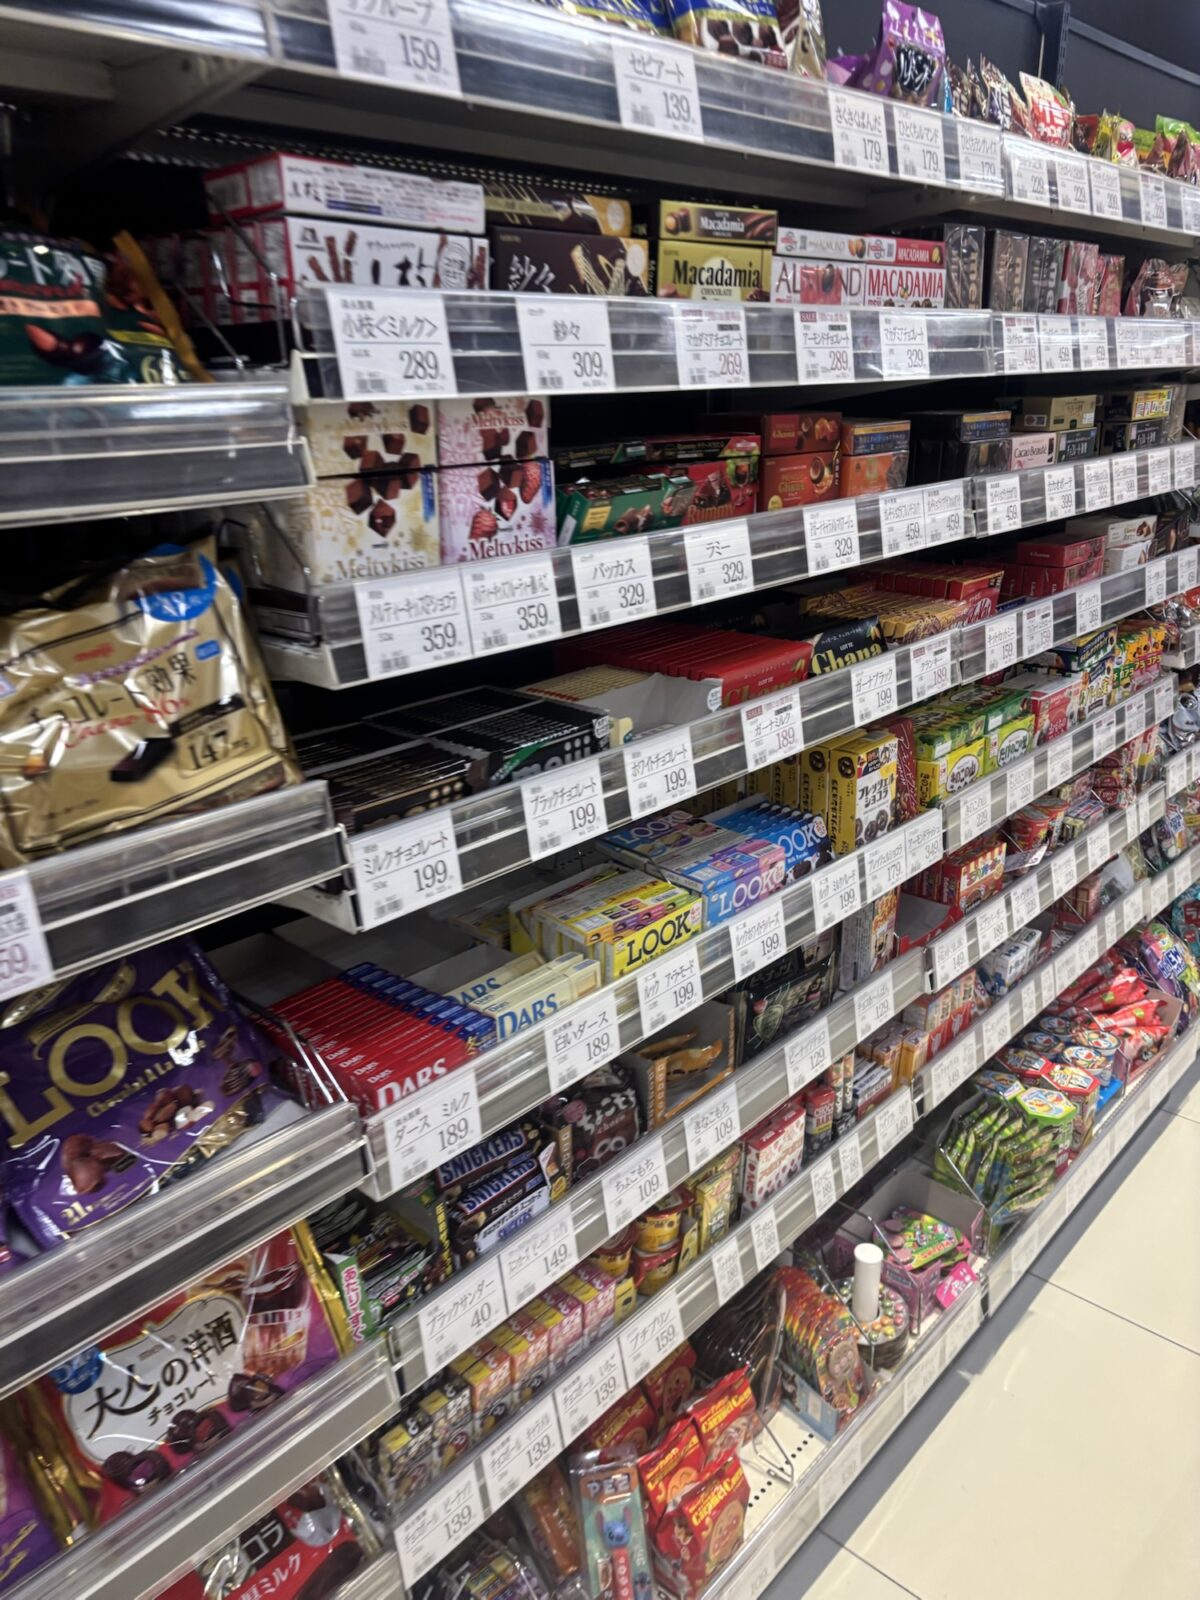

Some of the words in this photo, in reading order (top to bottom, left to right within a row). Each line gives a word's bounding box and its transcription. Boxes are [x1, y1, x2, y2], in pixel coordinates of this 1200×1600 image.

[399, 33, 442, 73] 159
[664, 91, 691, 122] 139
[862, 138, 881, 162] 179
[922, 149, 939, 171] 179
[699, 216, 745, 233] Macadamia
[897, 247, 930, 263] MACADAMIA
[673, 259, 761, 289] Macadamia
[868, 267, 944, 300] MACADAMIA
[401, 350, 439, 380] 289
[573, 350, 604, 379] 309
[719, 352, 743, 377] 269
[829, 349, 848, 372] 289
[907, 348, 924, 369] 329
[905, 521, 921, 541] 459
[946, 512, 961, 531] 459
[469, 534, 544, 562] Meltykiss
[705, 540, 732, 559] ラミー
[834, 537, 854, 559] 329
[722, 560, 744, 585] 329
[618, 583, 646, 609] 329
[516, 602, 549, 632] 359
[420, 622, 457, 653] 359
[811, 642, 882, 675] Ghana
[876, 688, 892, 708] 199
[753, 712, 792, 737] ガーナミルク
[776, 727, 795, 751] 189
[529, 776, 597, 815] ブラックチョコレート
[663, 768, 687, 794] 199
[569, 802, 596, 831] 199
[363, 831, 449, 876] ミルクチョコレート
[778, 822, 821, 858] OOK
[413, 860, 448, 893] 199
[887, 862, 902, 882] 179
[718, 862, 778, 916] LOOK
[839, 888, 855, 909] 199
[626, 909, 692, 967] LOOK
[760, 932, 780, 957] 199
[673, 981, 695, 1008] 199
[497, 992, 560, 1039] DARS
[554, 1011, 610, 1053] 白いダース
[0, 960, 224, 1149] LOOK
[586, 1033, 611, 1061] 189
[810, 1047, 825, 1069] 129
[376, 1056, 448, 1110] DARS
[393, 1115, 432, 1147] ダース
[441, 1092, 470, 1117] ミルク
[694, 1102, 731, 1135] きなこもち
[714, 1117, 733, 1143] 109
[438, 1117, 469, 1151] 189
[442, 1128, 525, 1186] SNICKERS
[615, 1160, 654, 1194] ちょこもち
[638, 1174, 660, 1200] 109
[542, 1243, 568, 1273] 149
[426, 1279, 495, 1335] ブラックサンダー
[470, 1302, 492, 1329] 40
[655, 1323, 676, 1352] 159
[84, 1310, 239, 1441] 大人の洋酒
[146, 1372, 219, 1428] チョコレート
[594, 1375, 617, 1407] 139
[525, 1435, 551, 1468] 139
[586, 1472, 631, 1497] PEZ
[443, 1505, 472, 1541] 139
